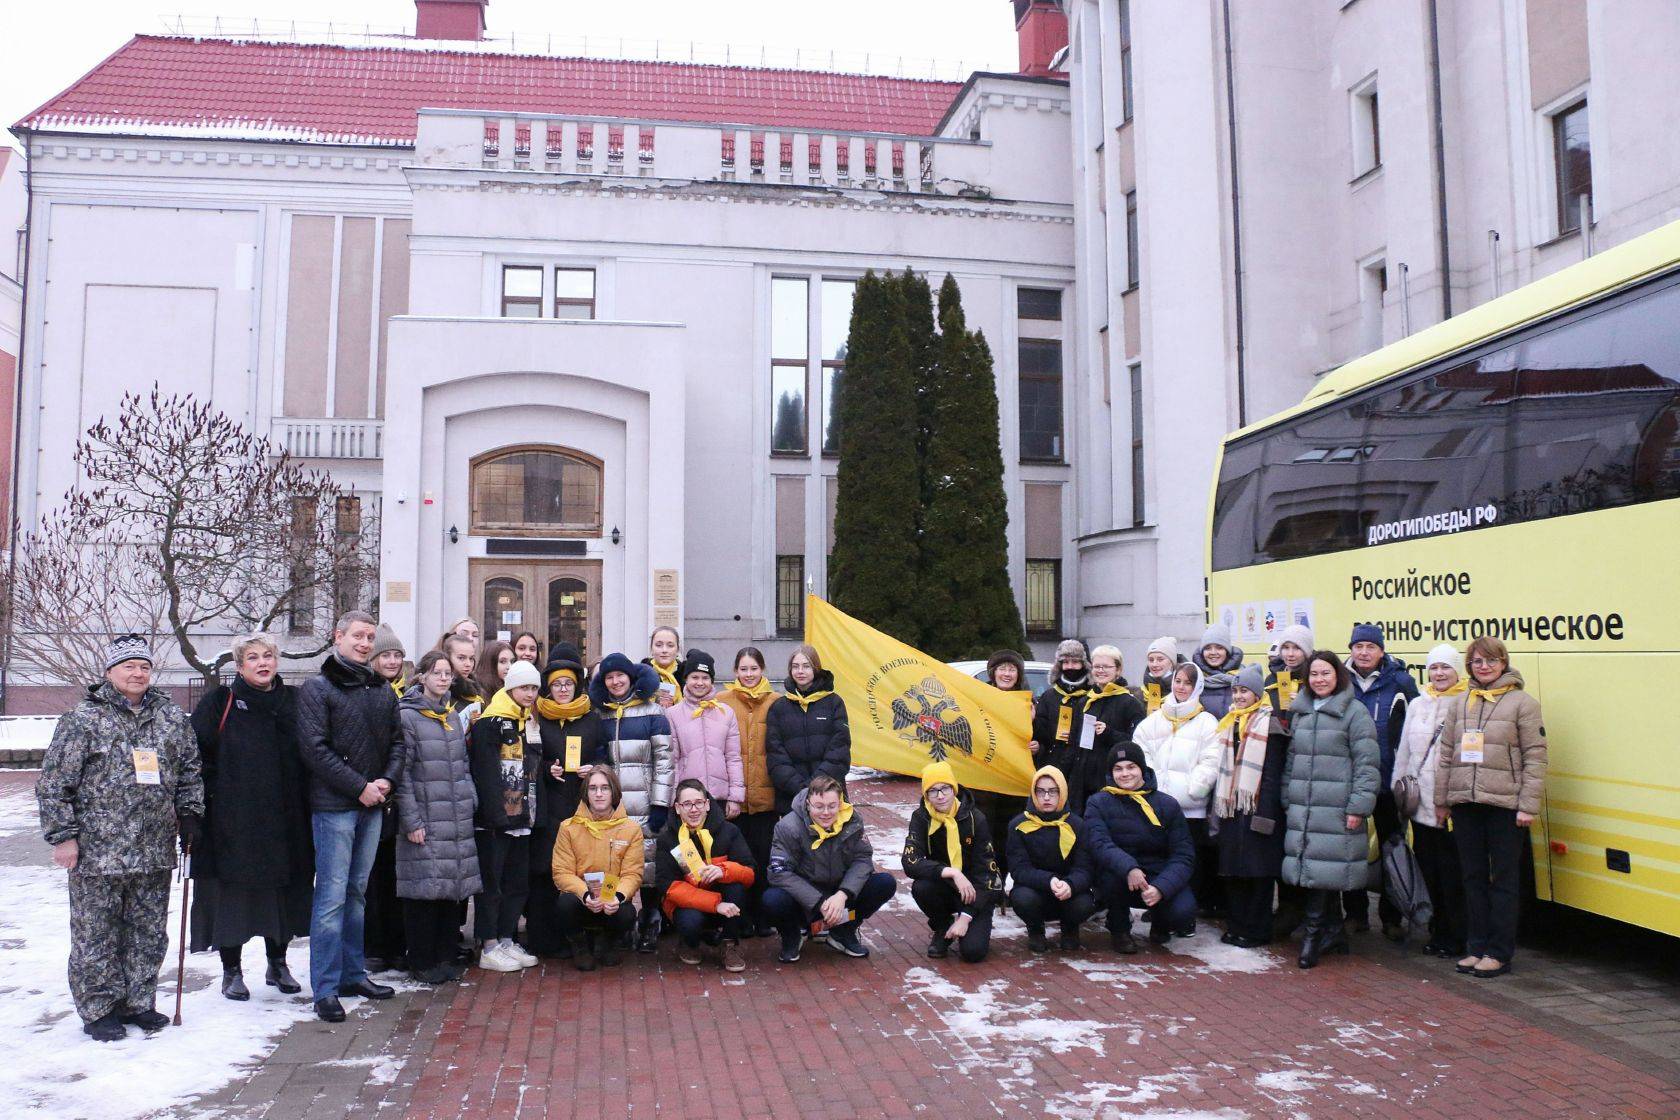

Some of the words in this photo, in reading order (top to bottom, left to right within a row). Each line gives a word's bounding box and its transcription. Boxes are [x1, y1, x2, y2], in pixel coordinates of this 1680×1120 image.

[1368, 508, 1471, 545] ДОРОГИПОБЕДЫ
[1475, 504, 1497, 525] РФ
[1352, 568, 1471, 600] Российское
[1353, 613, 1624, 642] нно-историческое
